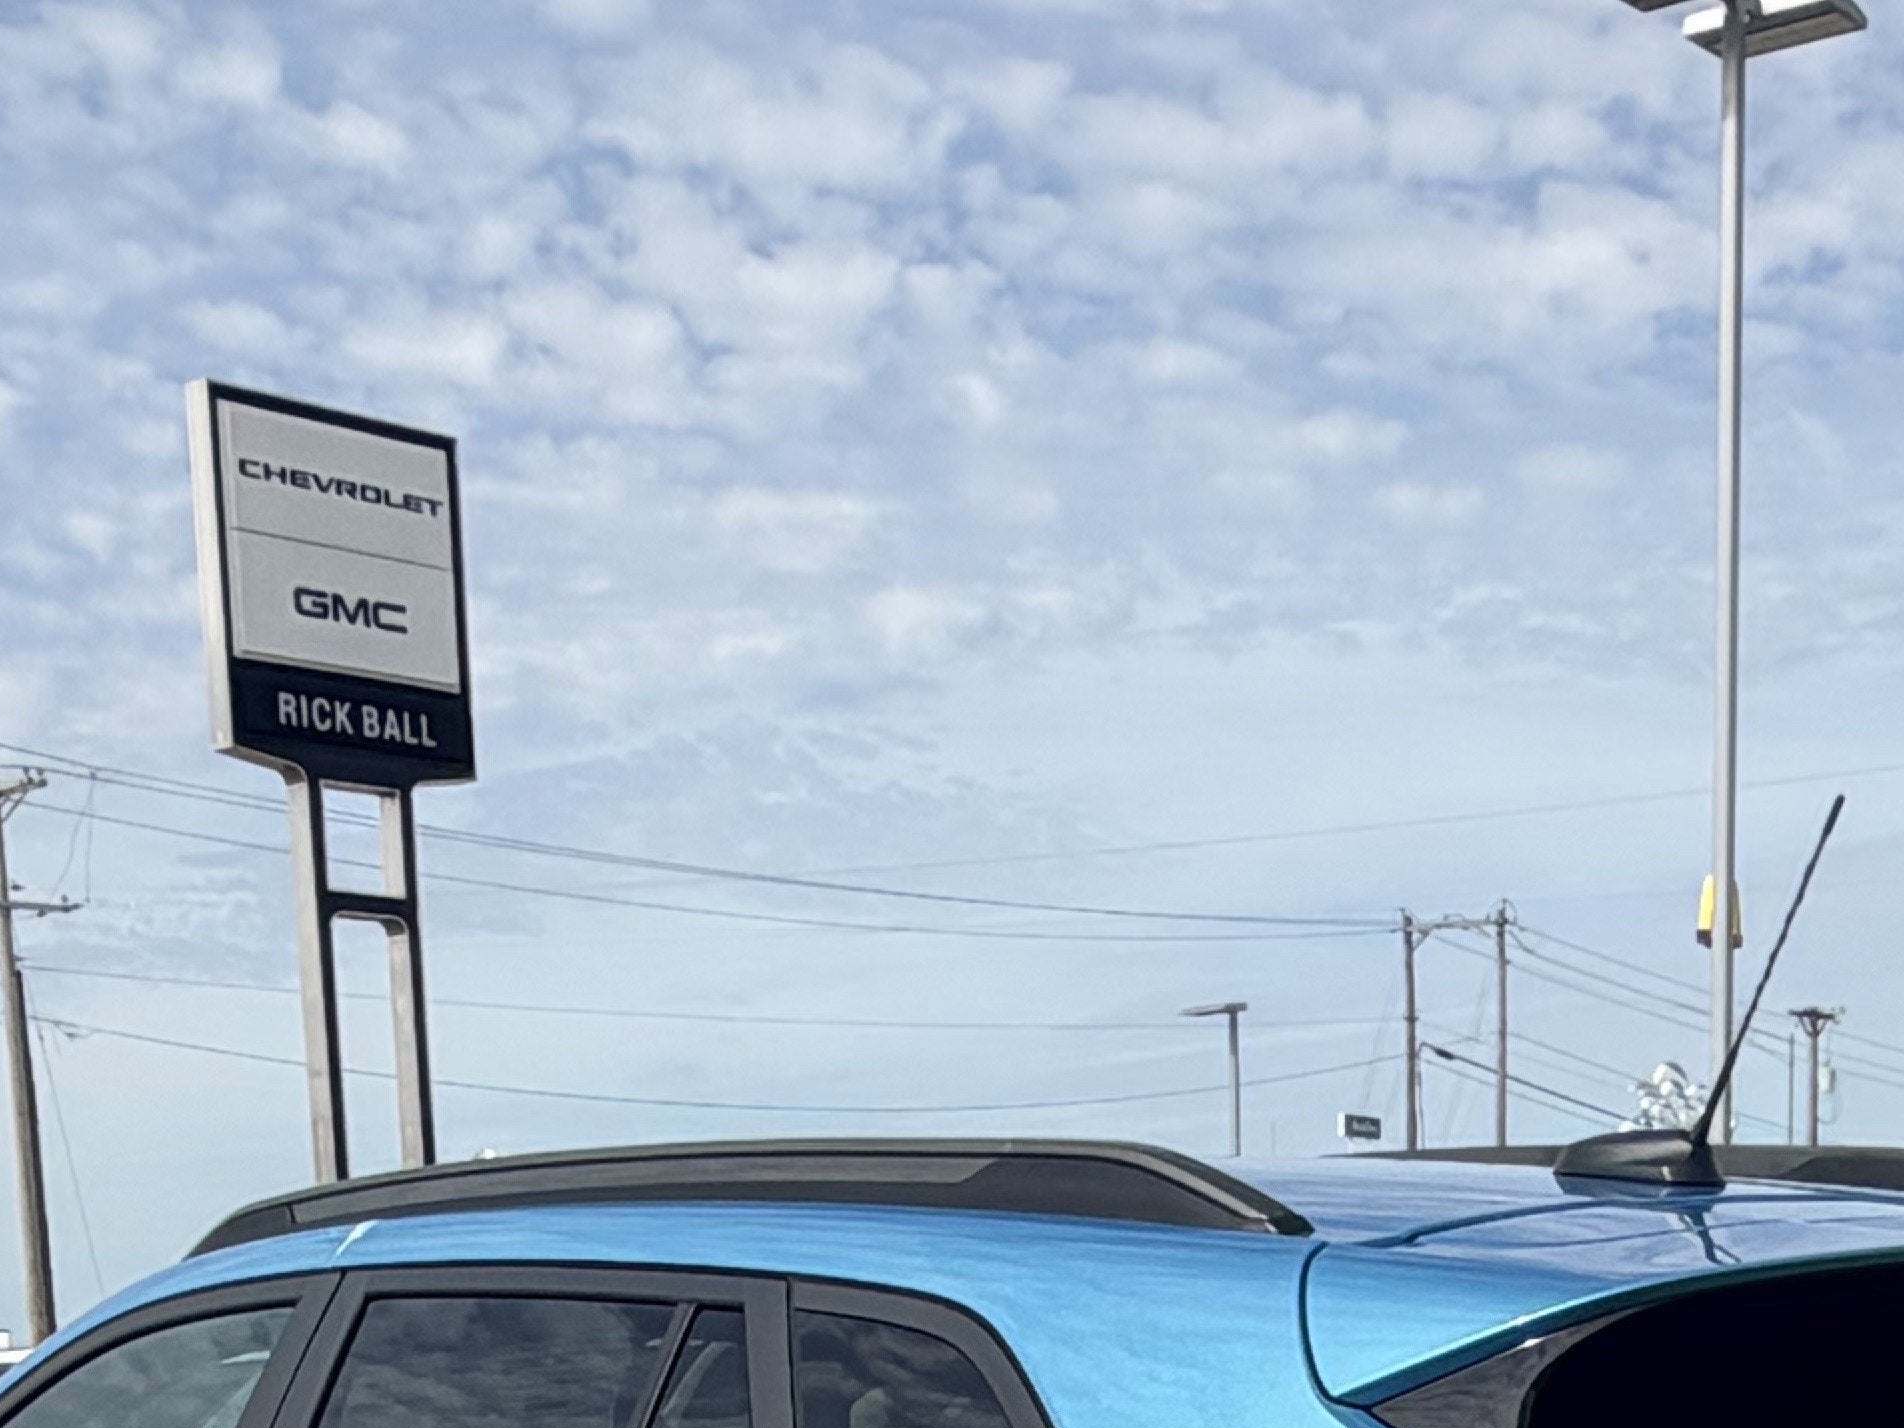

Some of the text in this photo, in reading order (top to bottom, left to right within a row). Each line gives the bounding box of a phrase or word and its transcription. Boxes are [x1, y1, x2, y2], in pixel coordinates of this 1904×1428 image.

[238, 457, 444, 518] CHEVROLET
[292, 586, 408, 634] GMC
[277, 691, 437, 748] RICK BALL
